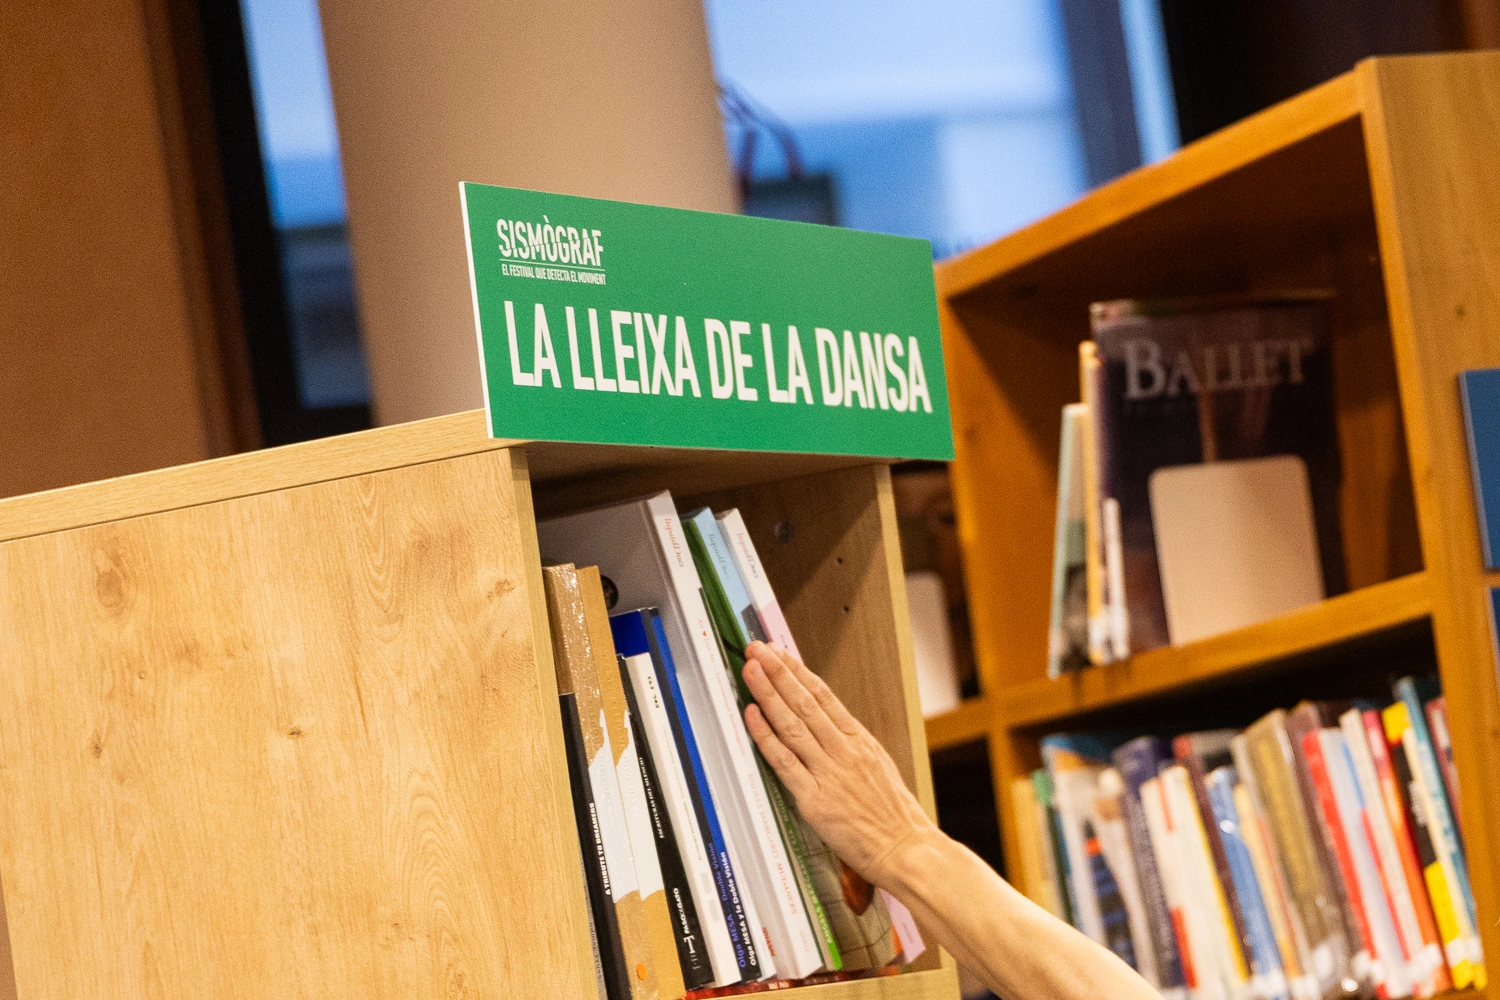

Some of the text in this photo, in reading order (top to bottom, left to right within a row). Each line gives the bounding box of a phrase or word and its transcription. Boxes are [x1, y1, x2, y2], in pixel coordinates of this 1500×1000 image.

[496, 214, 604, 266] SISMÒGRAF
[502, 264, 606, 285] EL FESTIVAL QUE DETECTA EL MOVIMENT
[504, 301, 933, 413] LA LLEIXA DE LA DANSA
[1121, 338, 1313, 400] BALLET
[589, 802, 611, 896] A TRIBUTE TO DREAMERS
[716, 871, 728, 901] Double
[726, 877, 739, 904] Doble
[734, 903, 742, 913] la
[737, 912, 745, 920] y
[726, 914, 738, 941] MESA
[739, 920, 751, 945] MESA
[735, 942, 746, 968] Olga
[746, 944, 757, 966] Olga
